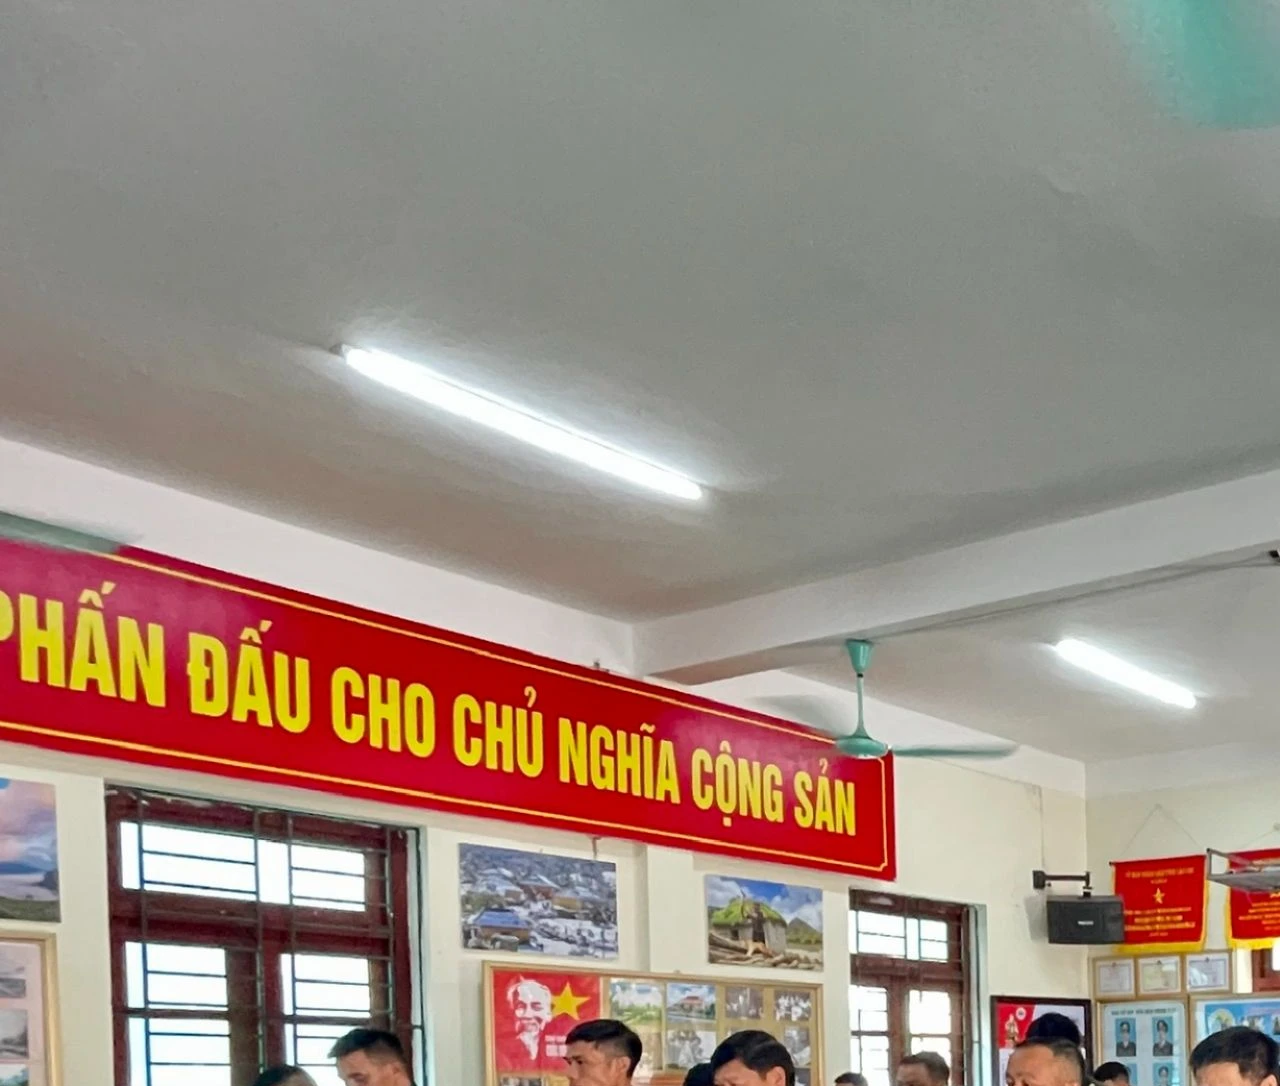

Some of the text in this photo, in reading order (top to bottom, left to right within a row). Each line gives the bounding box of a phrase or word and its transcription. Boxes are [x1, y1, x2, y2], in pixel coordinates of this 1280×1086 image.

[186, 619, 311, 734] ĐẤU
[331, 666, 436, 758] CHO
[453, 686, 544, 778] CHỦ
[558, 717, 681, 804] NGHĨA
[691, 740, 784, 827] CỘNG
[793, 757, 856, 836] SẢN
